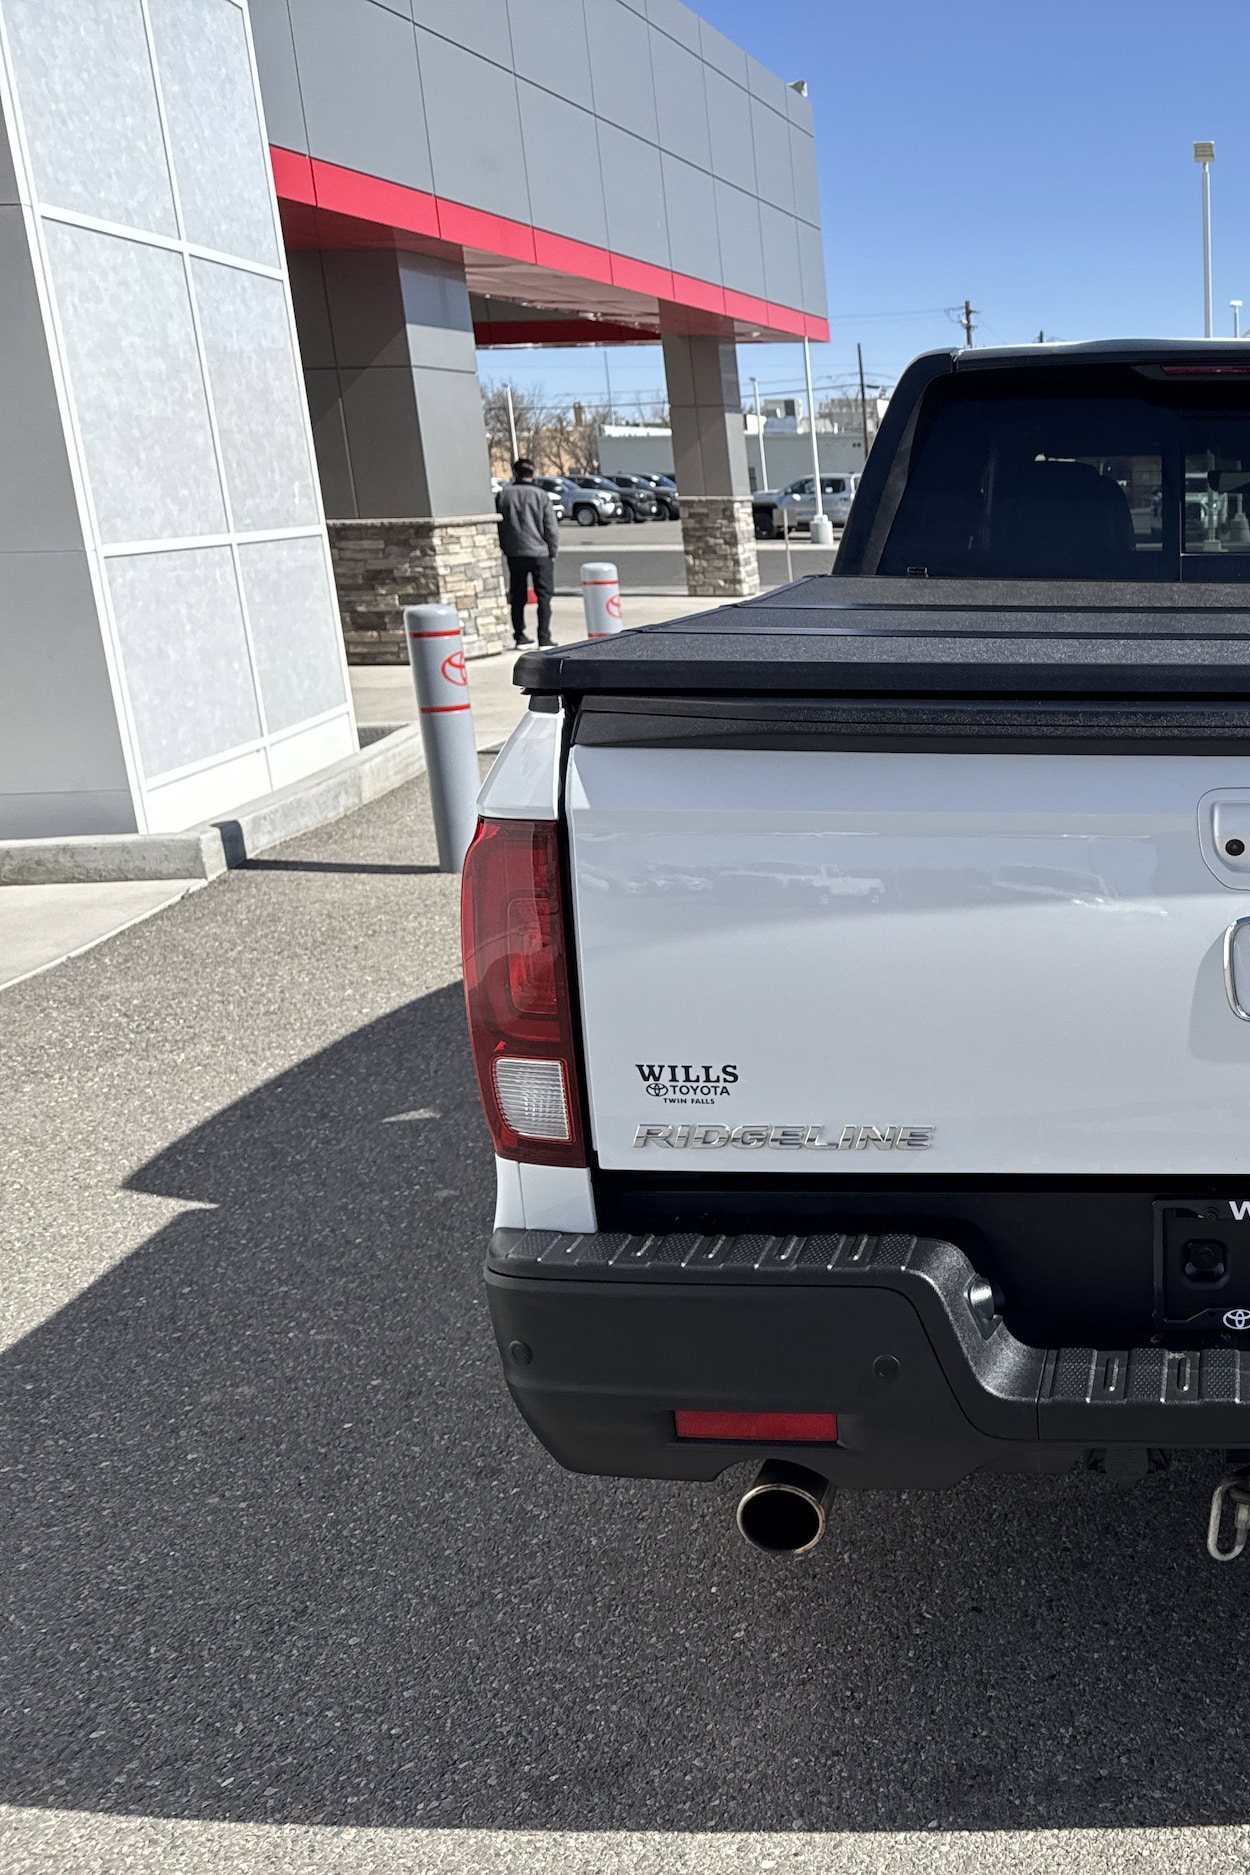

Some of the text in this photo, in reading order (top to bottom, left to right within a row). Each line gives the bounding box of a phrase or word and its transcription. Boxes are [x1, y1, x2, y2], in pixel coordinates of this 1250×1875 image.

[635, 1064, 739, 1083] WILLS
[669, 1084, 731, 1096] TOYOTA
[632, 1123, 936, 1150] RIDGELINE
